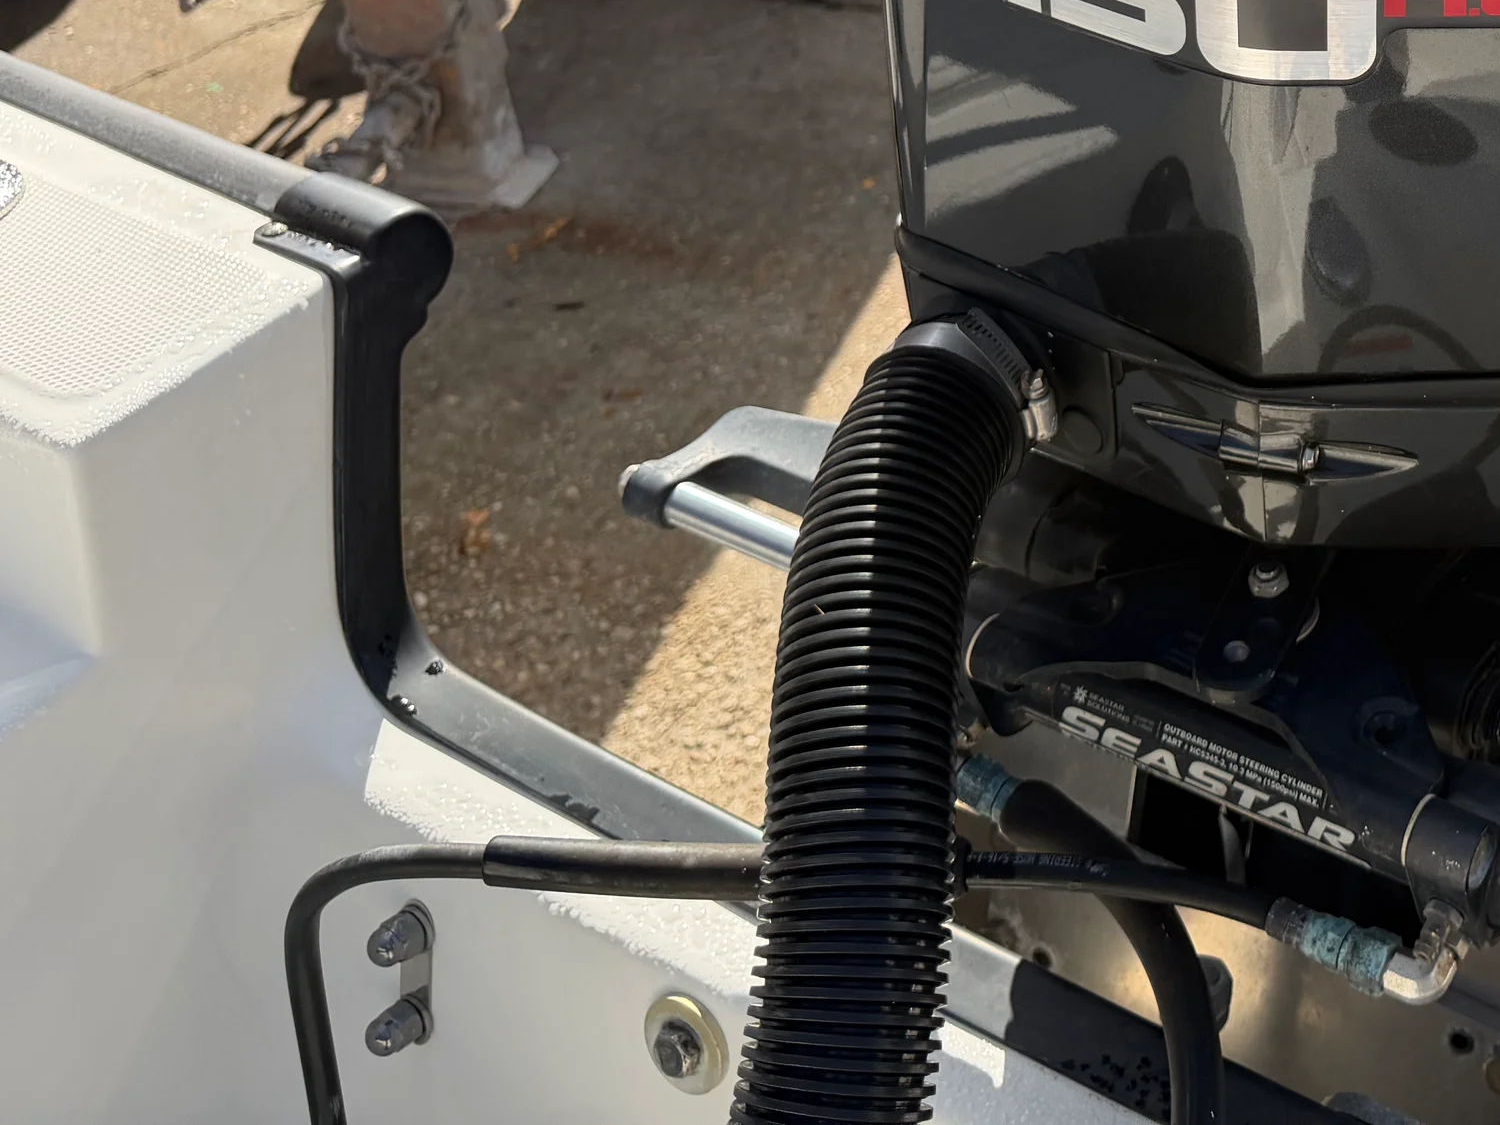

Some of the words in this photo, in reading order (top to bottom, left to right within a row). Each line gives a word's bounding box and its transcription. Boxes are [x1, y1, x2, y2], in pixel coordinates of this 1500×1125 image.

[1161, 733, 1183, 748] PART
[1299, 792, 1320, 808] MAX.
[1163, 723, 1208, 747] OUTBOARD
[1208, 741, 1238, 761] MOTOR
[1240, 755, 1280, 779] STEERING
[1281, 773, 1323, 797] CYLINDER
